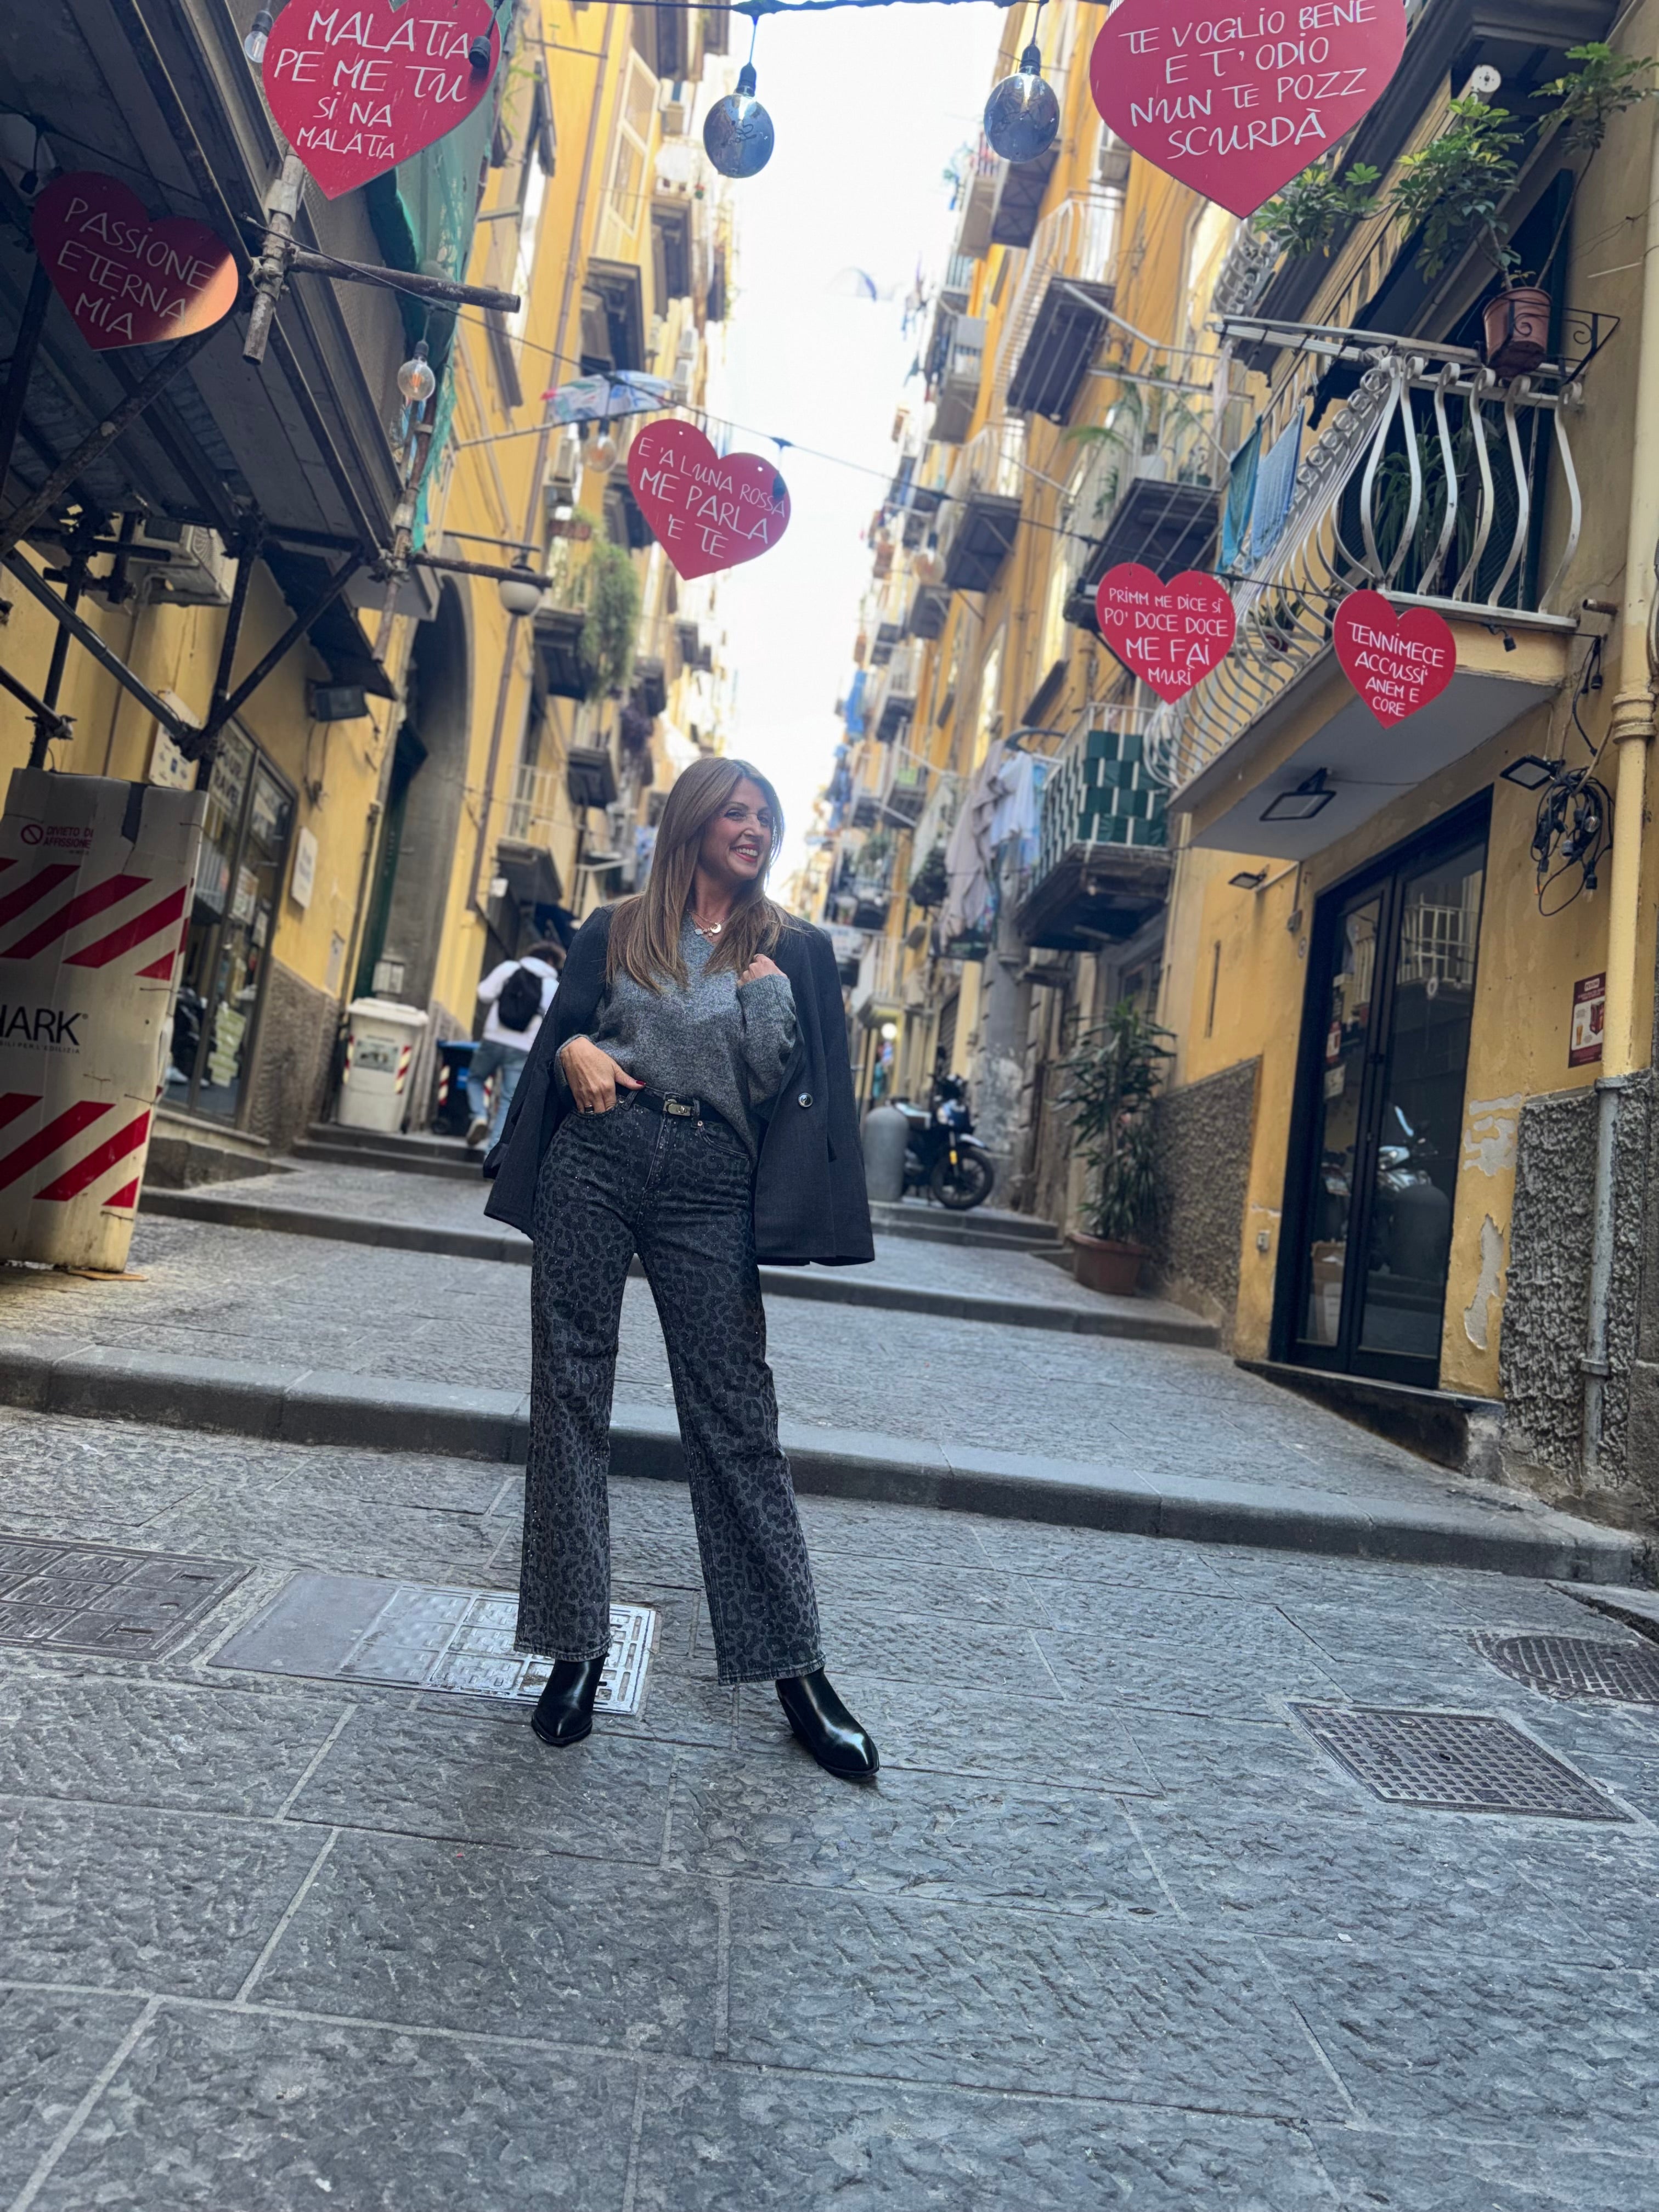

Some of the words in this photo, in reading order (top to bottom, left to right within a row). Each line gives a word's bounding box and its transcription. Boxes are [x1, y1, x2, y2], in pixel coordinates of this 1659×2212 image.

[308, 8, 469, 60] MALATIA
[1118, 27, 1160, 54] TE
[1172, 8, 1285, 48] VOGLIO
[1299, 0, 1377, 30] BENE
[274, 48, 324, 82] PE
[333, 59, 393, 92] ME
[405, 65, 467, 103] TU
[1165, 54, 1188, 84] E
[313, 92, 341, 120] SI
[349, 101, 392, 127] NA
[1130, 89, 1211, 127] NUN
[1222, 83, 1260, 109] TE
[1277, 67, 1367, 103] POZZ
[296, 126, 394, 159] MALATIA
[1166, 108, 1325, 160] SCURDÀ
[64, 198, 216, 292] PASSIONE
[57, 240, 187, 326] ETERNA
[75, 292, 132, 340] MIA
[638, 437, 654, 458] E
[680, 455, 733, 494] LUNA
[740, 484, 785, 518] ROSSA
[639, 467, 680, 503] ME
[686, 486, 768, 544] PARLA
[695, 522, 729, 559] TE
[1109, 586, 1149, 606] PRIMM
[1155, 595, 1172, 608] ME
[1177, 594, 1207, 612] DICE
[1135, 611, 1179, 632] DOCE
[1185, 617, 1229, 637] DOCE
[1126, 636, 1161, 661] ME
[1170, 638, 1210, 665] FAI
[1347, 622, 1446, 668] TENNIMECE
[1365, 676, 1404, 699] ANEM
[1409, 687, 1420, 703] E
[1373, 696, 1406, 717] CORE
[43, 837, 92, 849] AFFISSIONE
[46, 826, 80, 837] DIVIETO
[84, 828, 94, 838] DI
